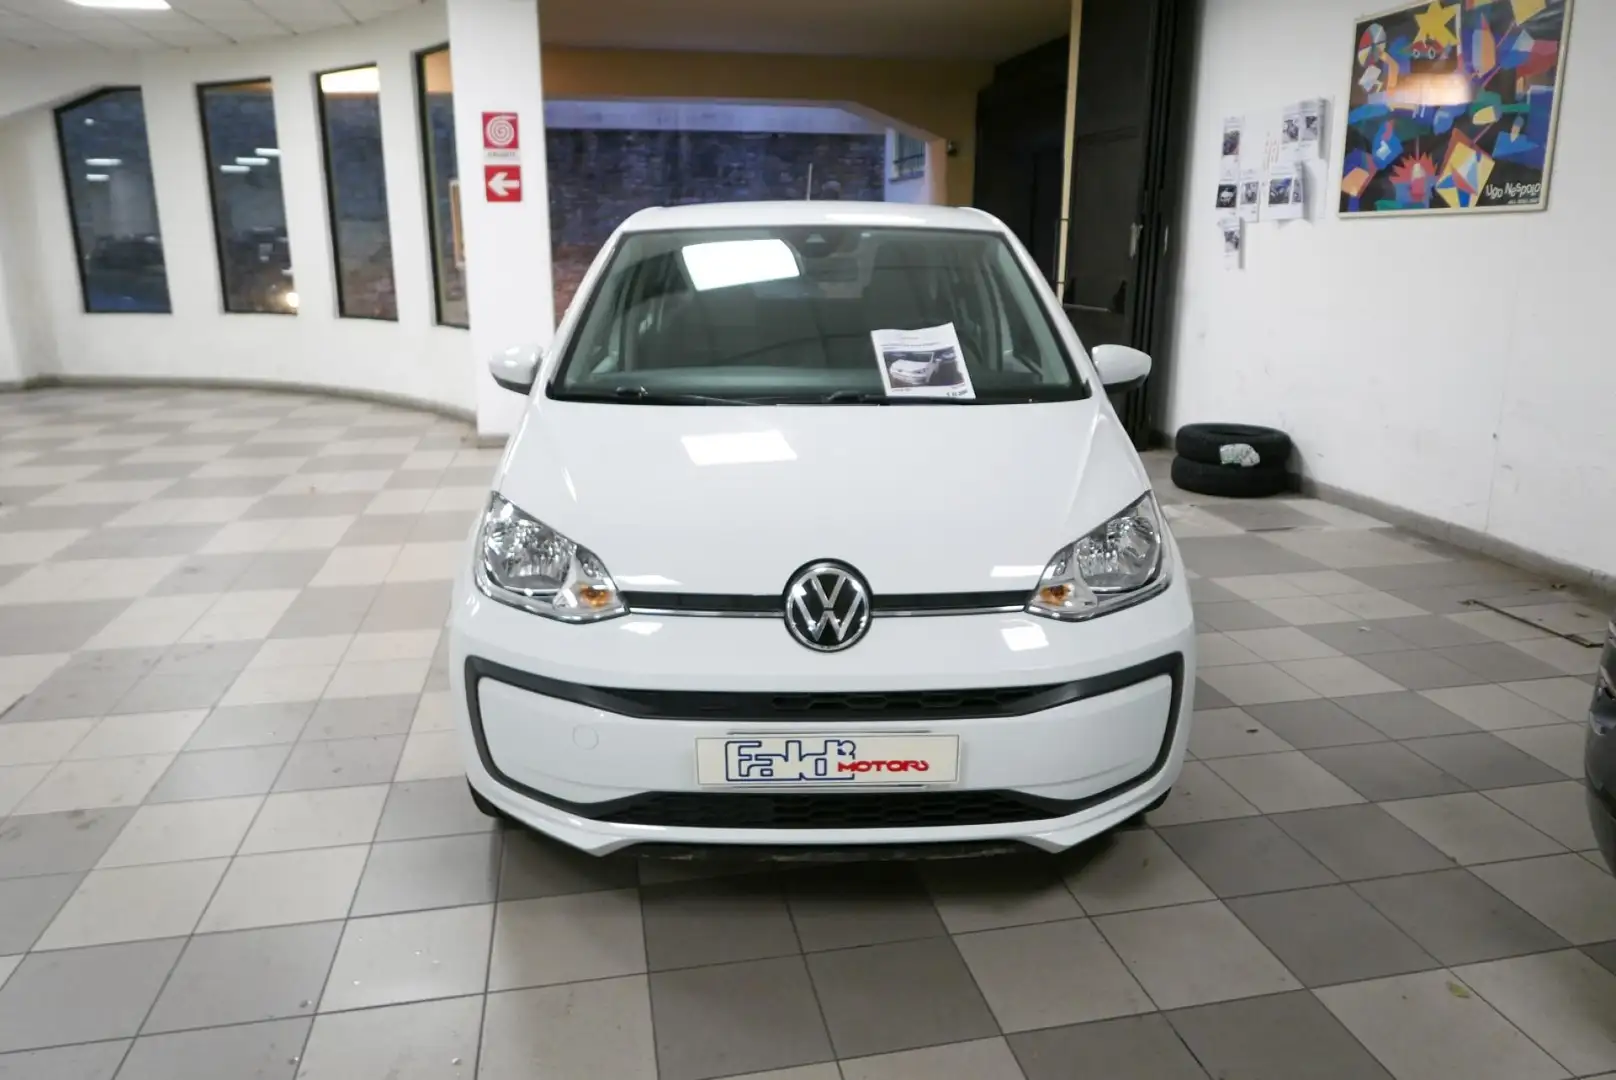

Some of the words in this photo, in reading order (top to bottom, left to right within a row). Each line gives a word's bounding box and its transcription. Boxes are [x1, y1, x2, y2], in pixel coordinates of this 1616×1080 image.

[1485, 184, 1503, 199] Ugo
[788, 567, 867, 644] VW
[837, 759, 929, 773] MOTORS
